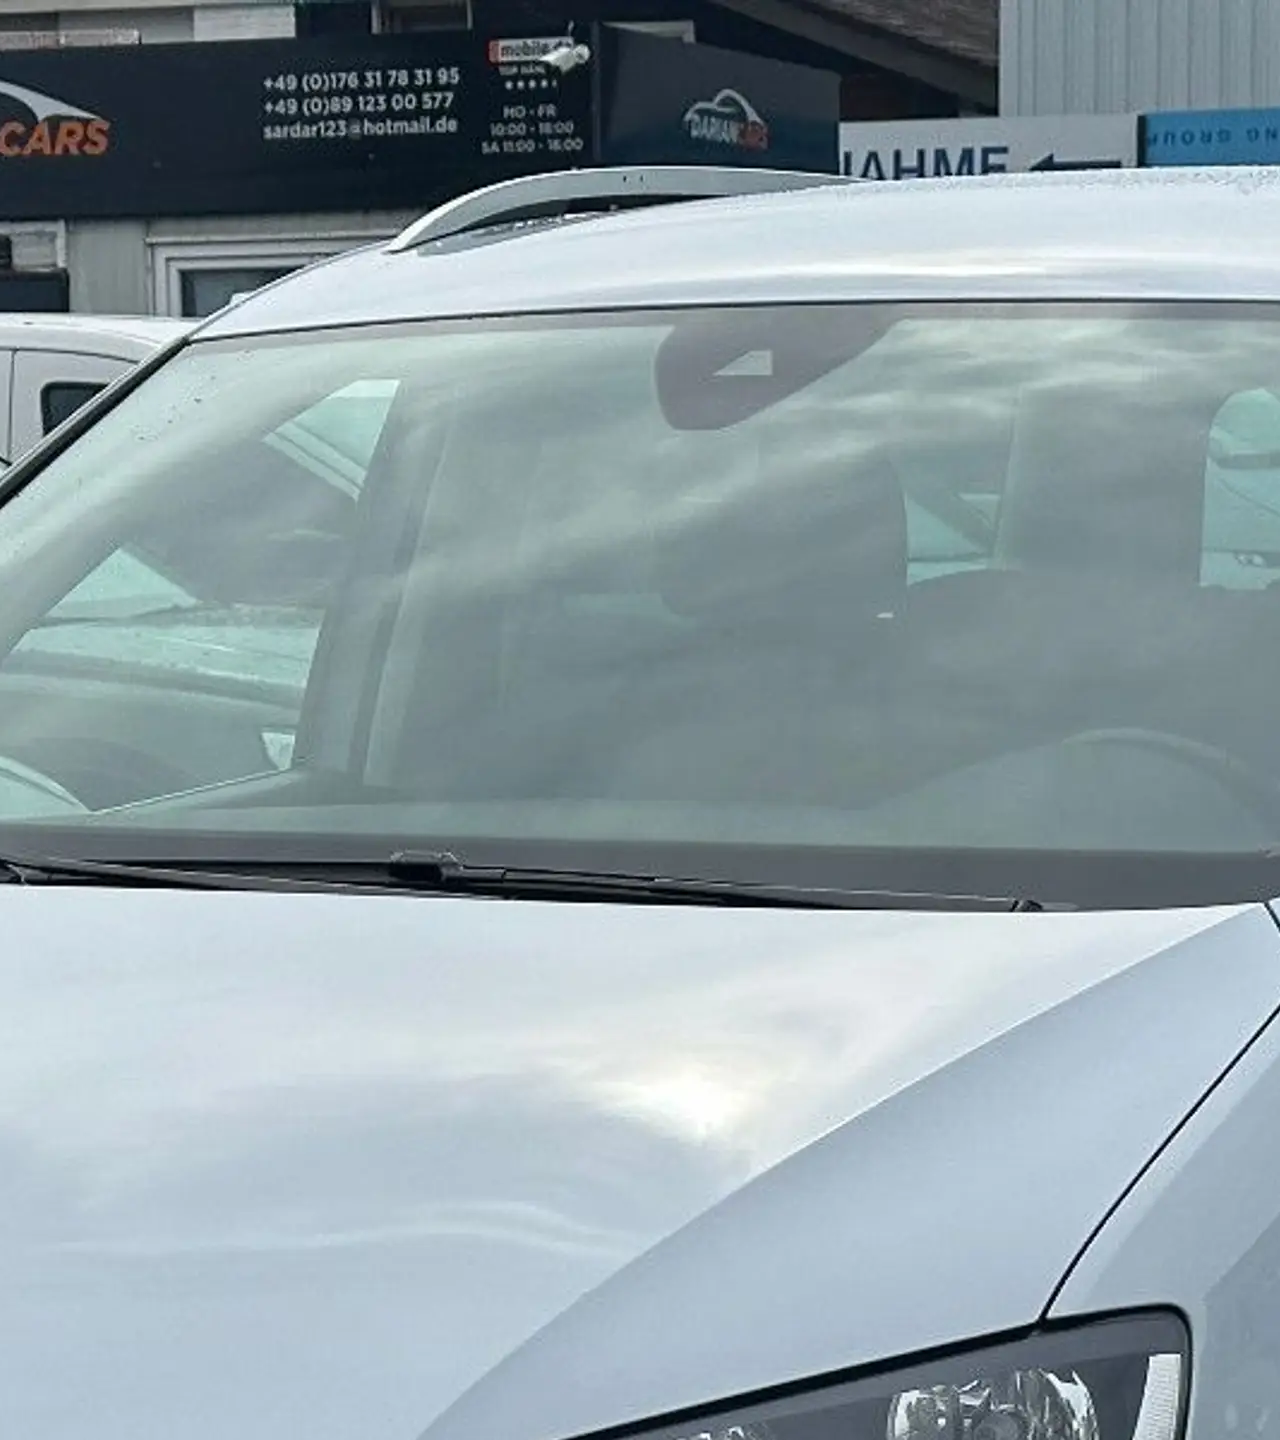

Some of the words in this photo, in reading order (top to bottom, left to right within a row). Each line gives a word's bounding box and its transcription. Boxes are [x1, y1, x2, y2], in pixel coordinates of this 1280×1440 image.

[263, 74, 298, 91] +49
[302, 72, 359, 92] (0)176
[364, 71, 382, 88] 31
[387, 69, 409, 86] 78
[414, 68, 432, 85] 31
[437, 67, 460, 85] 95
[265, 98, 298, 115] +49
[302, 96, 353, 116] (0)89
[358, 95, 387, 112] 123
[391, 94, 417, 110] 00
[421, 92, 454, 109] 577
